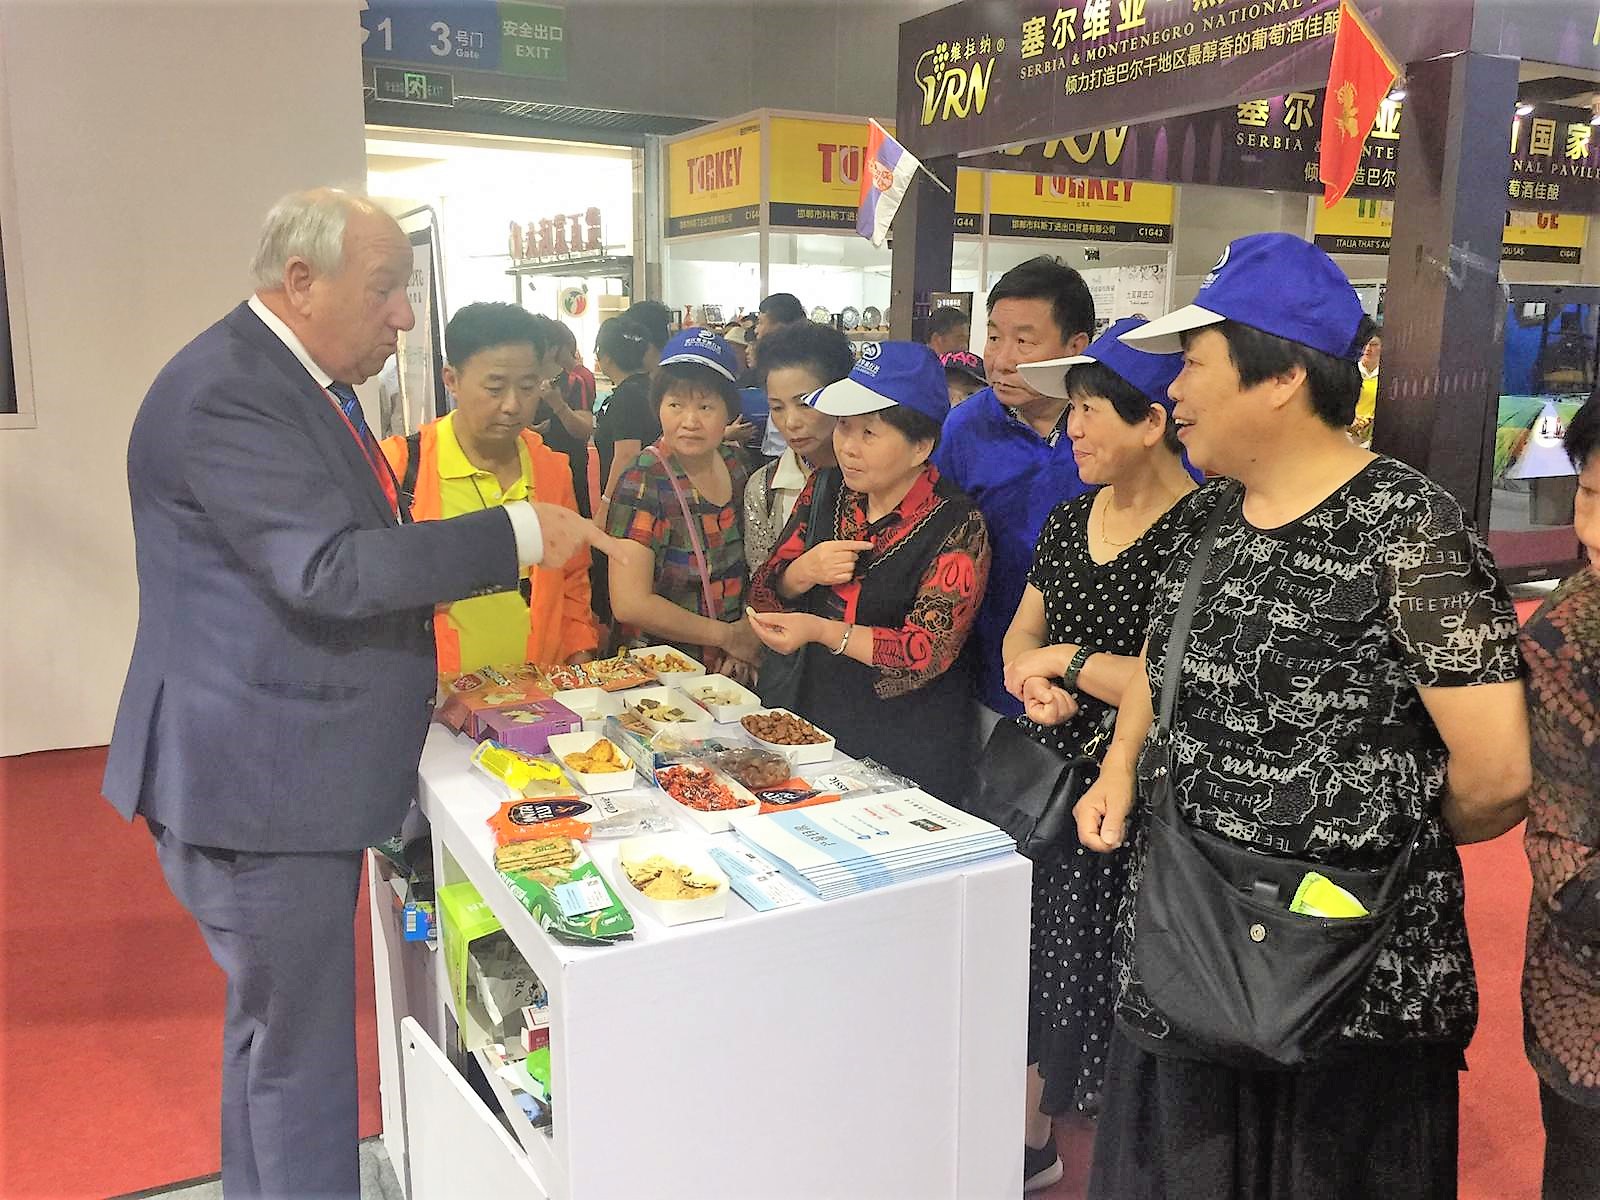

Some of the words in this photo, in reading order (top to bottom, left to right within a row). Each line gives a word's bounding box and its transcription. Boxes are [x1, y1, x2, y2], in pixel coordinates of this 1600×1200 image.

[377, 17, 393, 51] 1
[430, 21, 452, 57] 3
[455, 30, 484, 49] 号门
[503, 19, 563, 42] 安全出口
[455, 47, 481, 60] Gate
[515, 44, 551, 60] EXIT
[950, 34, 992, 63] 维拉纳
[1019, 58, 1066, 80] SERBIA
[1071, 52, 1081, 66] &
[1086, 21, 1195, 63] MONTENEGRO
[919, 57, 996, 126] VRN
[1236, 132, 1303, 153] SERBIA
[686, 146, 742, 194] TURKEY
[1513, 159, 1543, 174] NAL
[1033, 175, 1134, 202] TURKEY
[1138, 228, 1164, 238] C1G43
